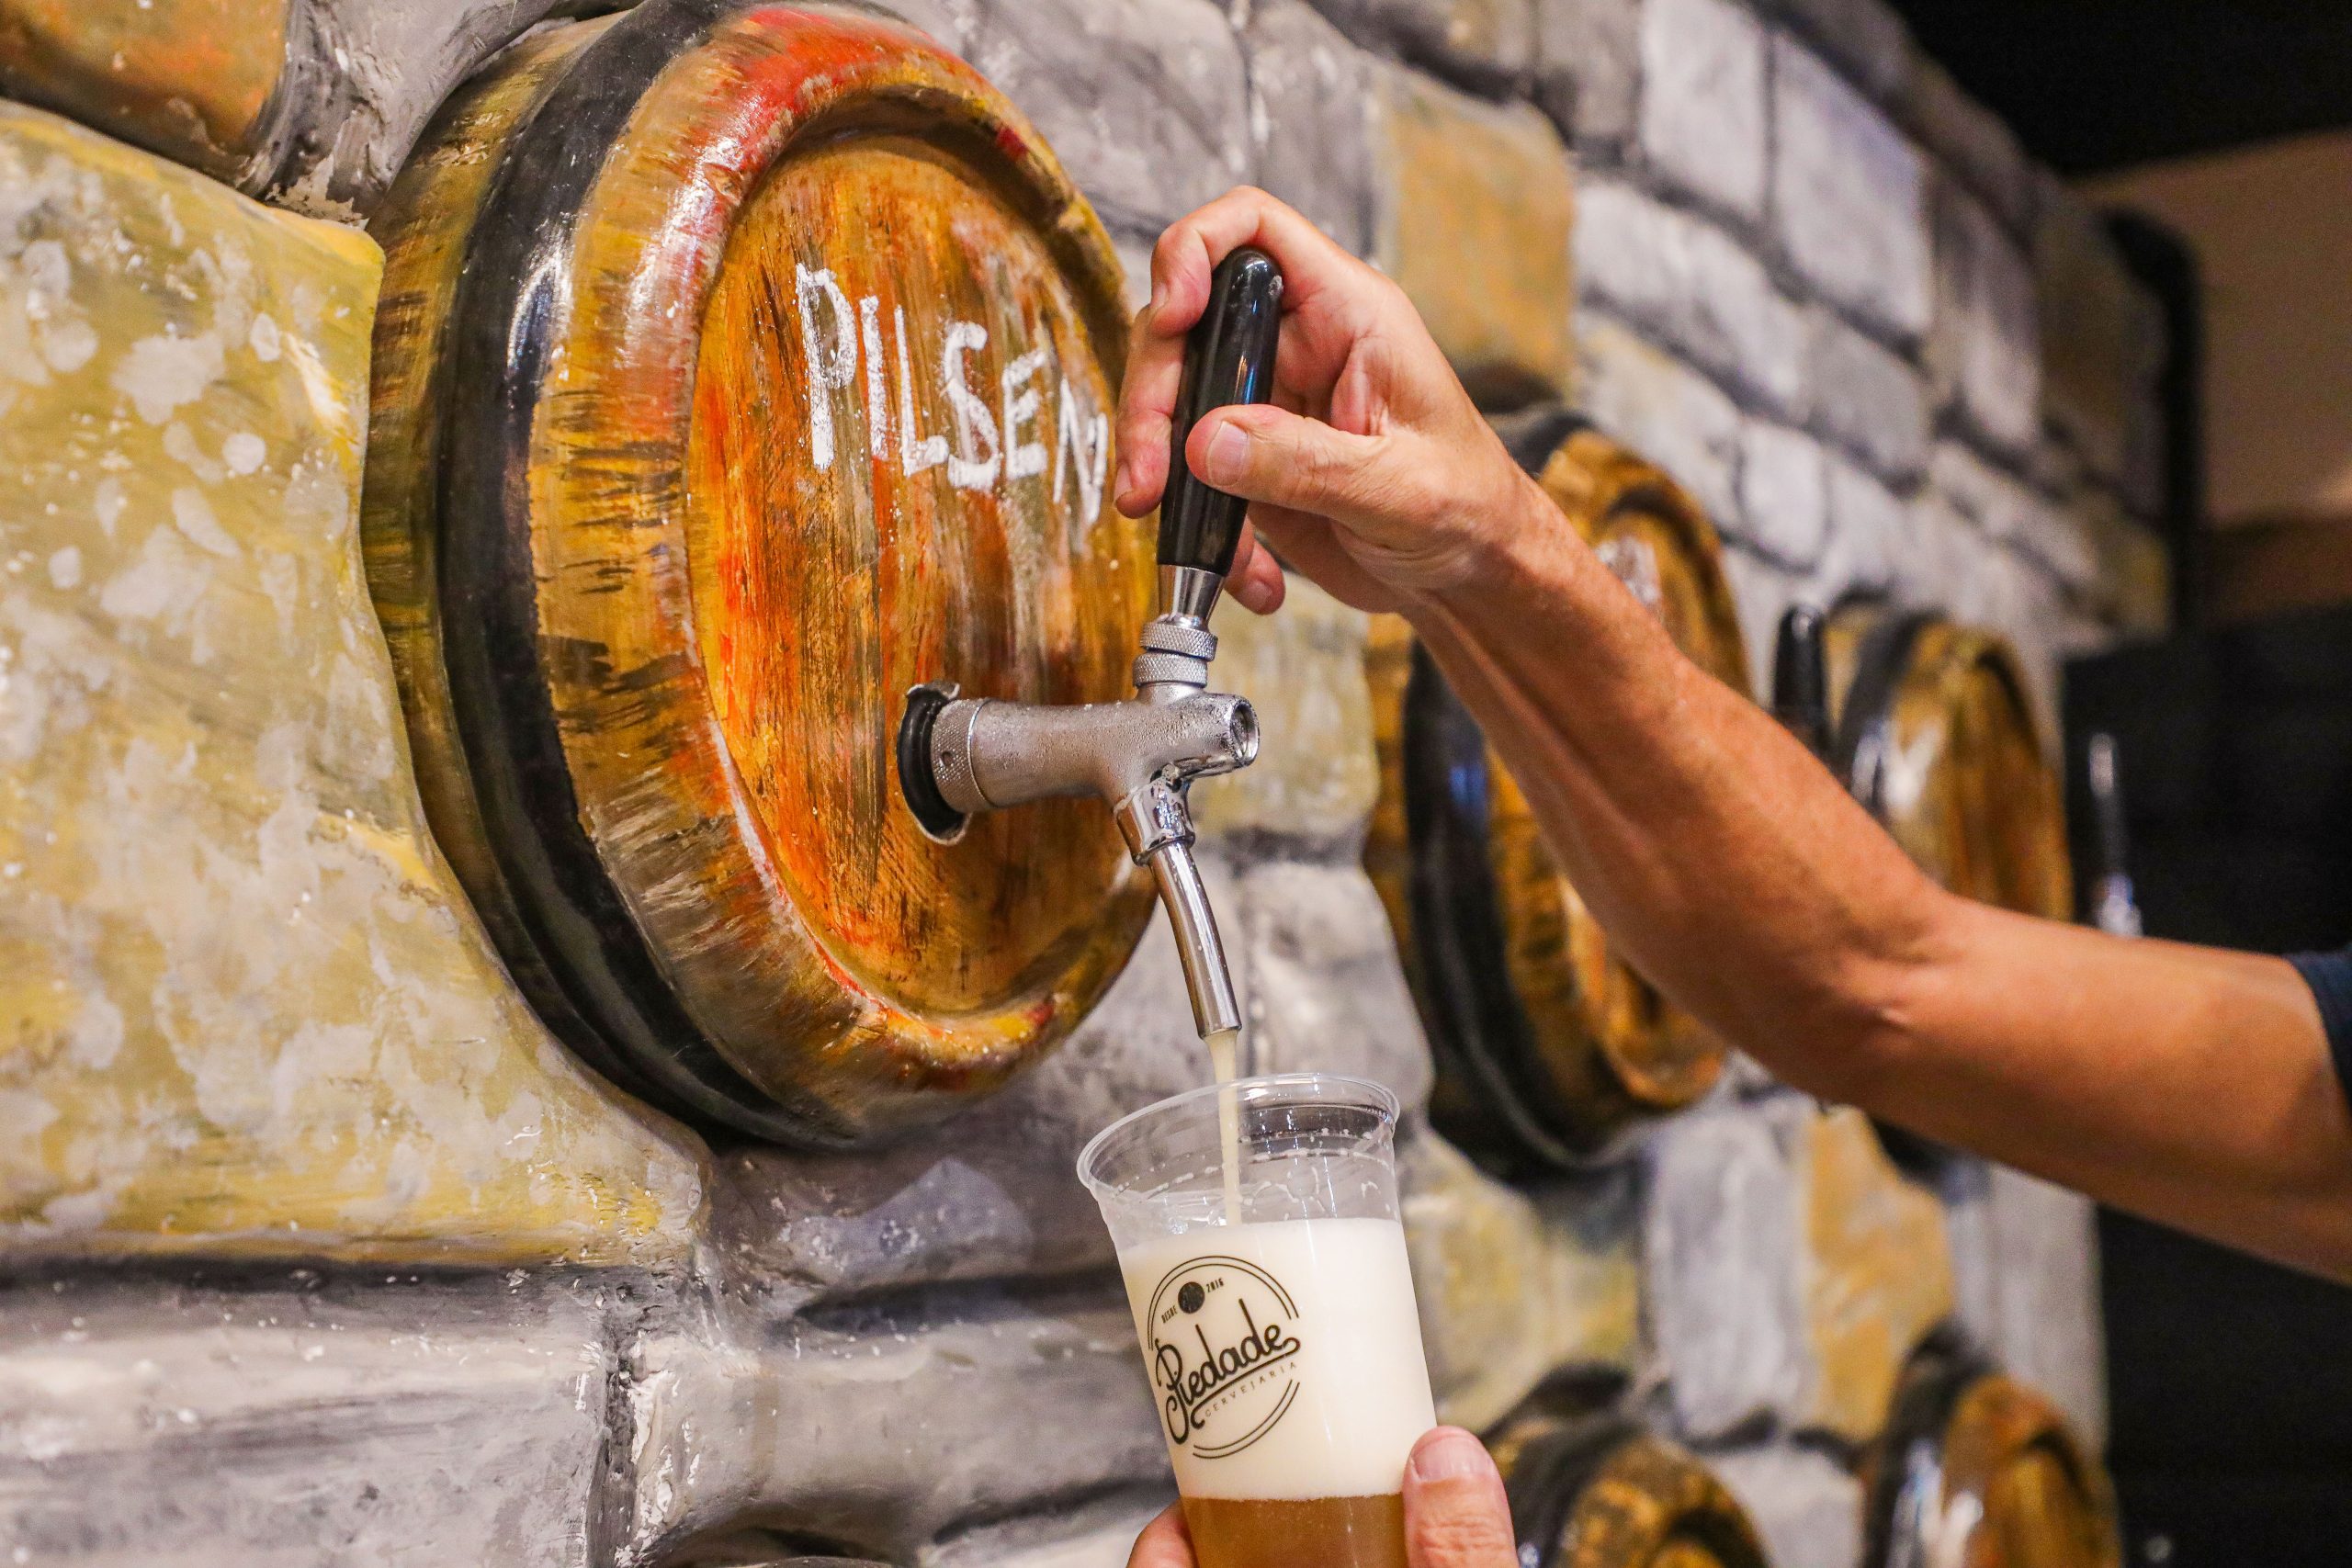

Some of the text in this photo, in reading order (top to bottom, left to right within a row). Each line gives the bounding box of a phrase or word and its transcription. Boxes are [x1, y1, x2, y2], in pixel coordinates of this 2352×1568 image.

[795, 263, 1109, 524] PILSEN
[1155, 1298, 1301, 1445] Piedade
[1204, 1361, 1296, 1417] CERVEJARIA
